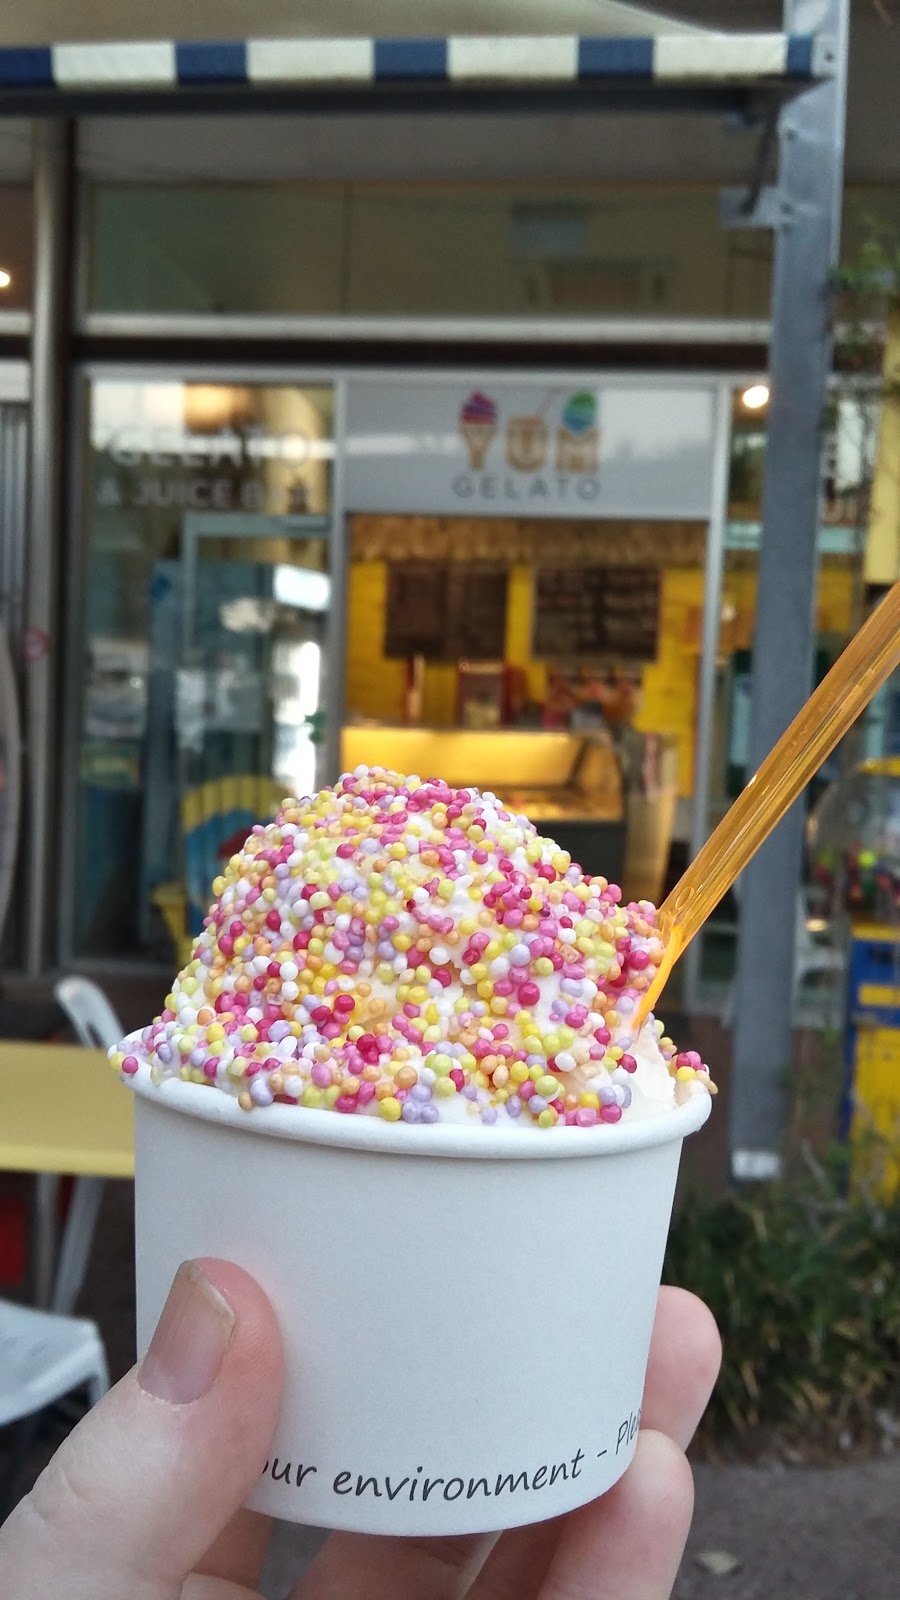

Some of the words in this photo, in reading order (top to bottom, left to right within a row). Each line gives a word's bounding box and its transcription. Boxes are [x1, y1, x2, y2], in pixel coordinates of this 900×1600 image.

[457, 394, 600, 474] YUM
[132, 478, 233, 508] JUICE
[452, 474, 601, 500] GELATO
[262, 1457, 318, 1488] ur
[332, 1449, 585, 1502] environment
